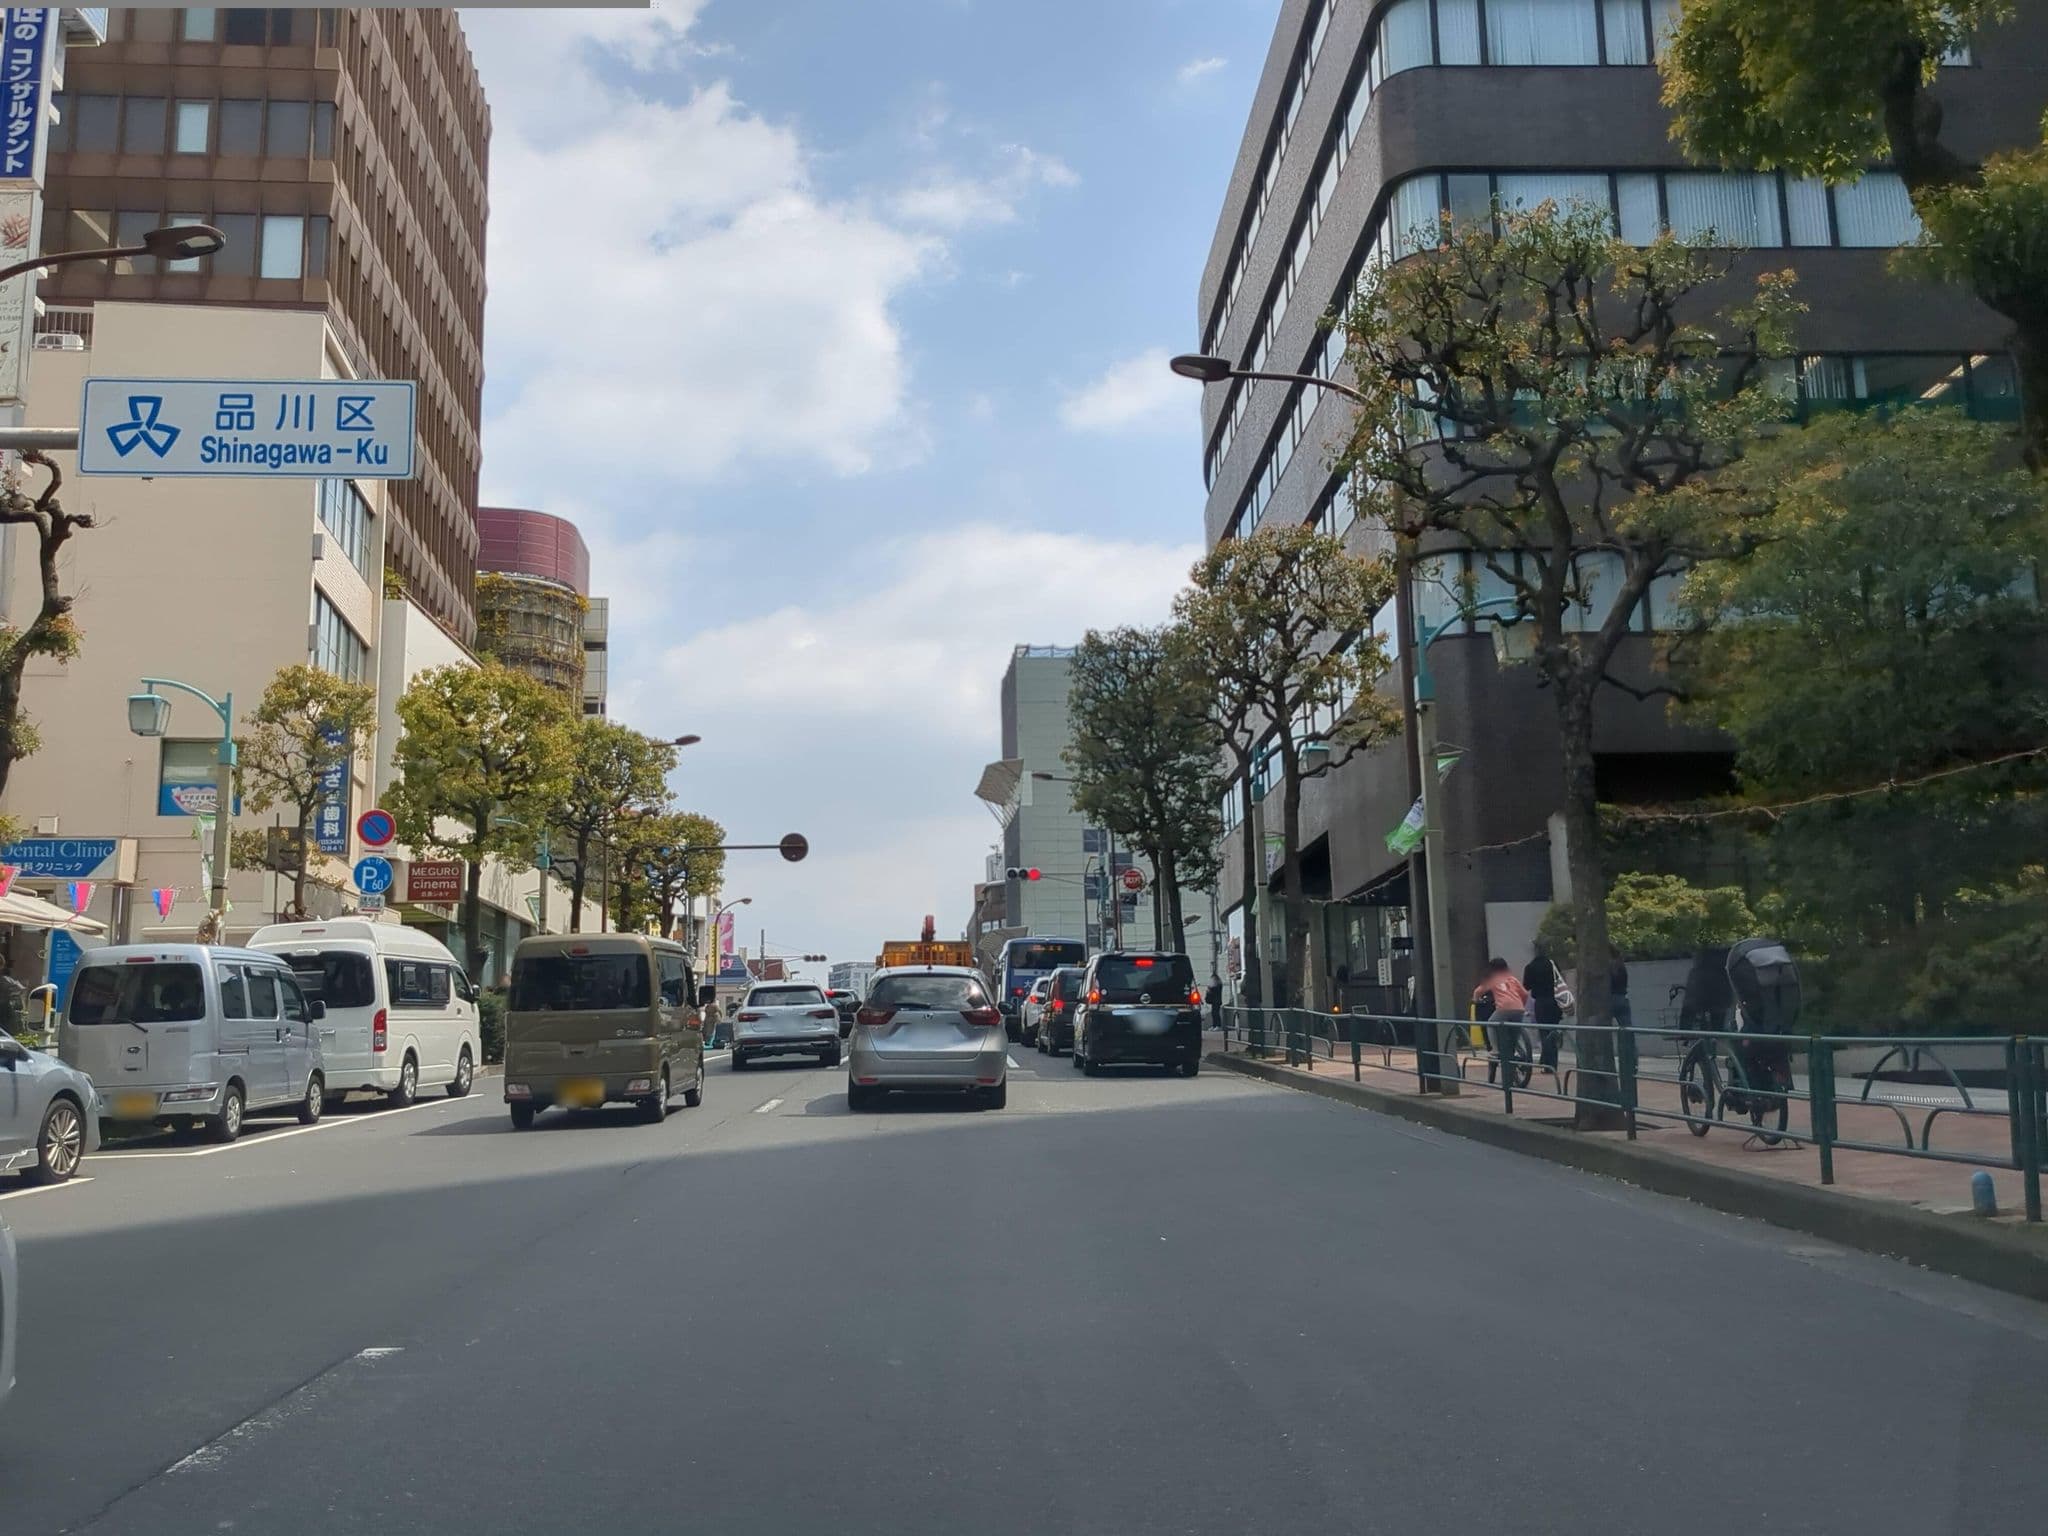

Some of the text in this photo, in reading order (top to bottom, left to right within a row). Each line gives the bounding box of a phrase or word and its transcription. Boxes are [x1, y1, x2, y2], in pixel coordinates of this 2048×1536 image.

[216, 394, 376, 432] 品川区
[200, 435, 389, 468] Shinagawa-Ku
[60, 841, 113, 858] Clinic
[361, 866, 378, 889] P
[411, 867, 460, 876] MEGURO
[412, 880, 458, 889] cinema
